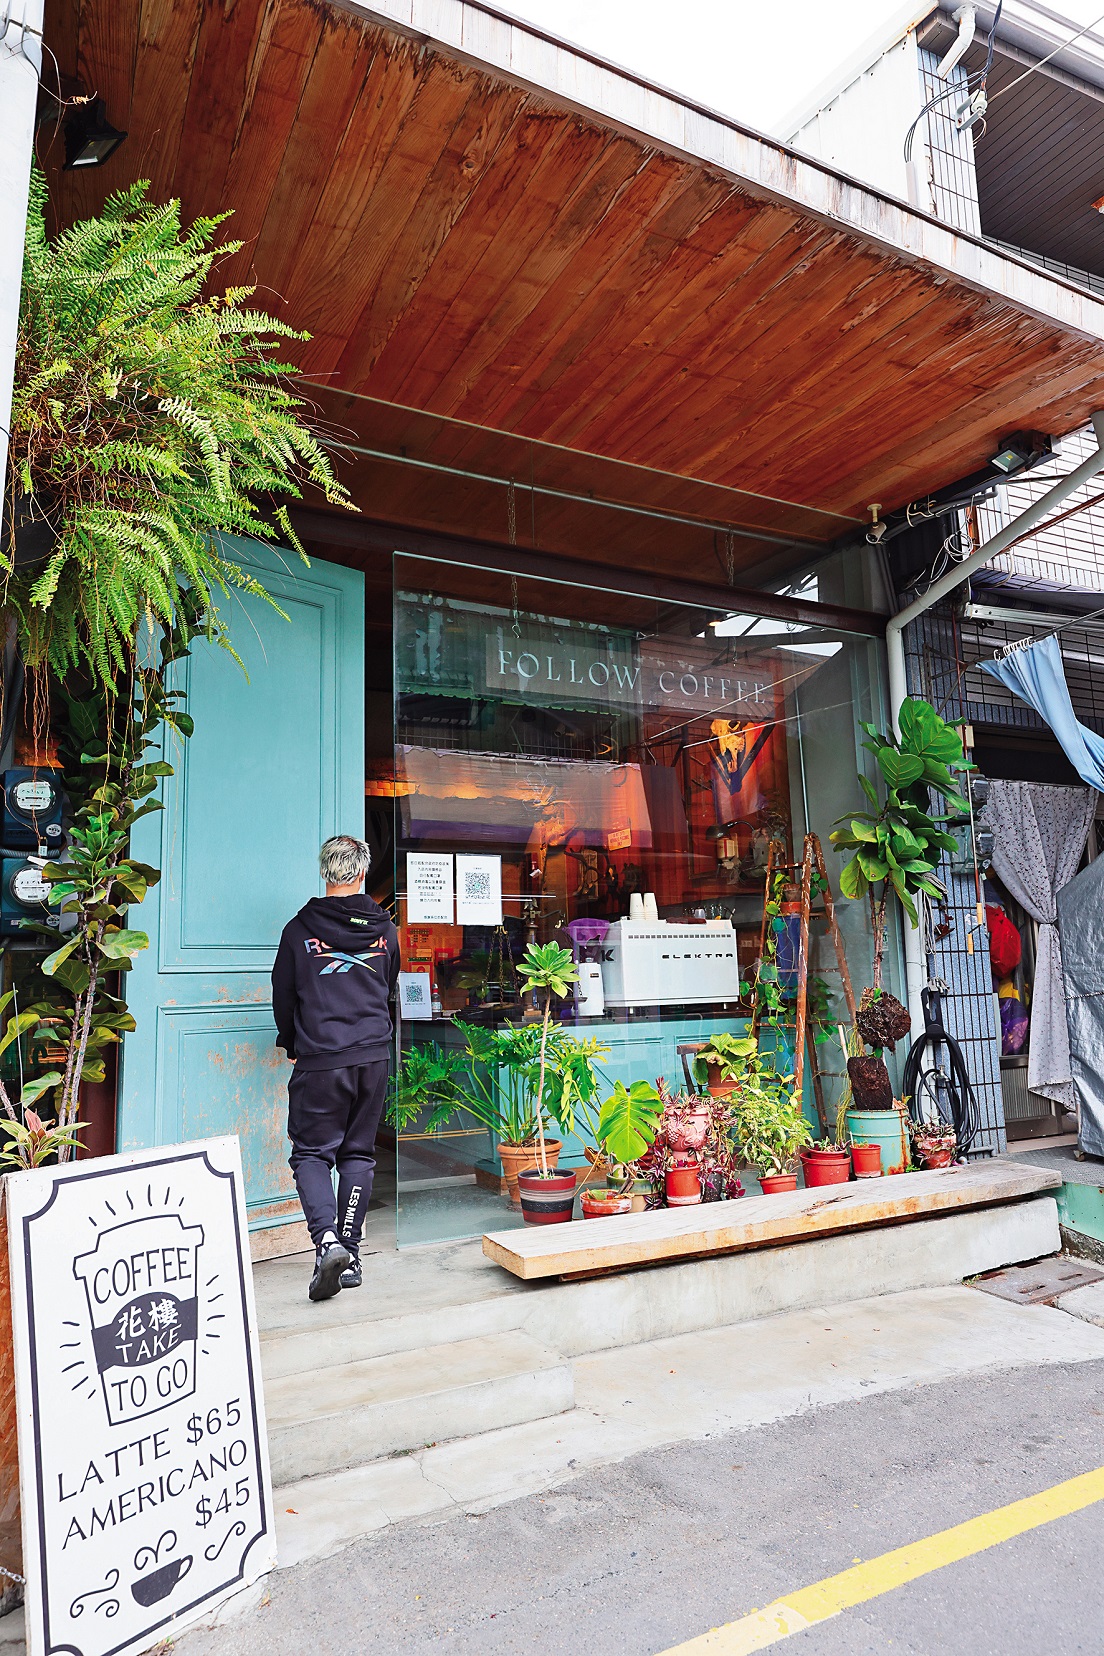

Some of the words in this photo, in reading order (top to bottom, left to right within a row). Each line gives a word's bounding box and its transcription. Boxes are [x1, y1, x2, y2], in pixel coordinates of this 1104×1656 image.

[498, 650, 640, 690] FOLLOW
[659, 671, 766, 704] COFFEE
[342, 1206, 356, 1238] MILLS
[348, 1185, 362, 1207] LES
[93, 1247, 193, 1304] COFFEE
[114, 1298, 180, 1342] 花樓
[114, 1323, 183, 1364] TAKE
[111, 1374, 148, 1413] TO
[156, 1358, 189, 1400] GO
[57, 1427, 171, 1503] LATTE
[186, 1397, 242, 1447] $65
[61, 1438, 249, 1551] AMERICANO
[195, 1476, 252, 1531] $45
